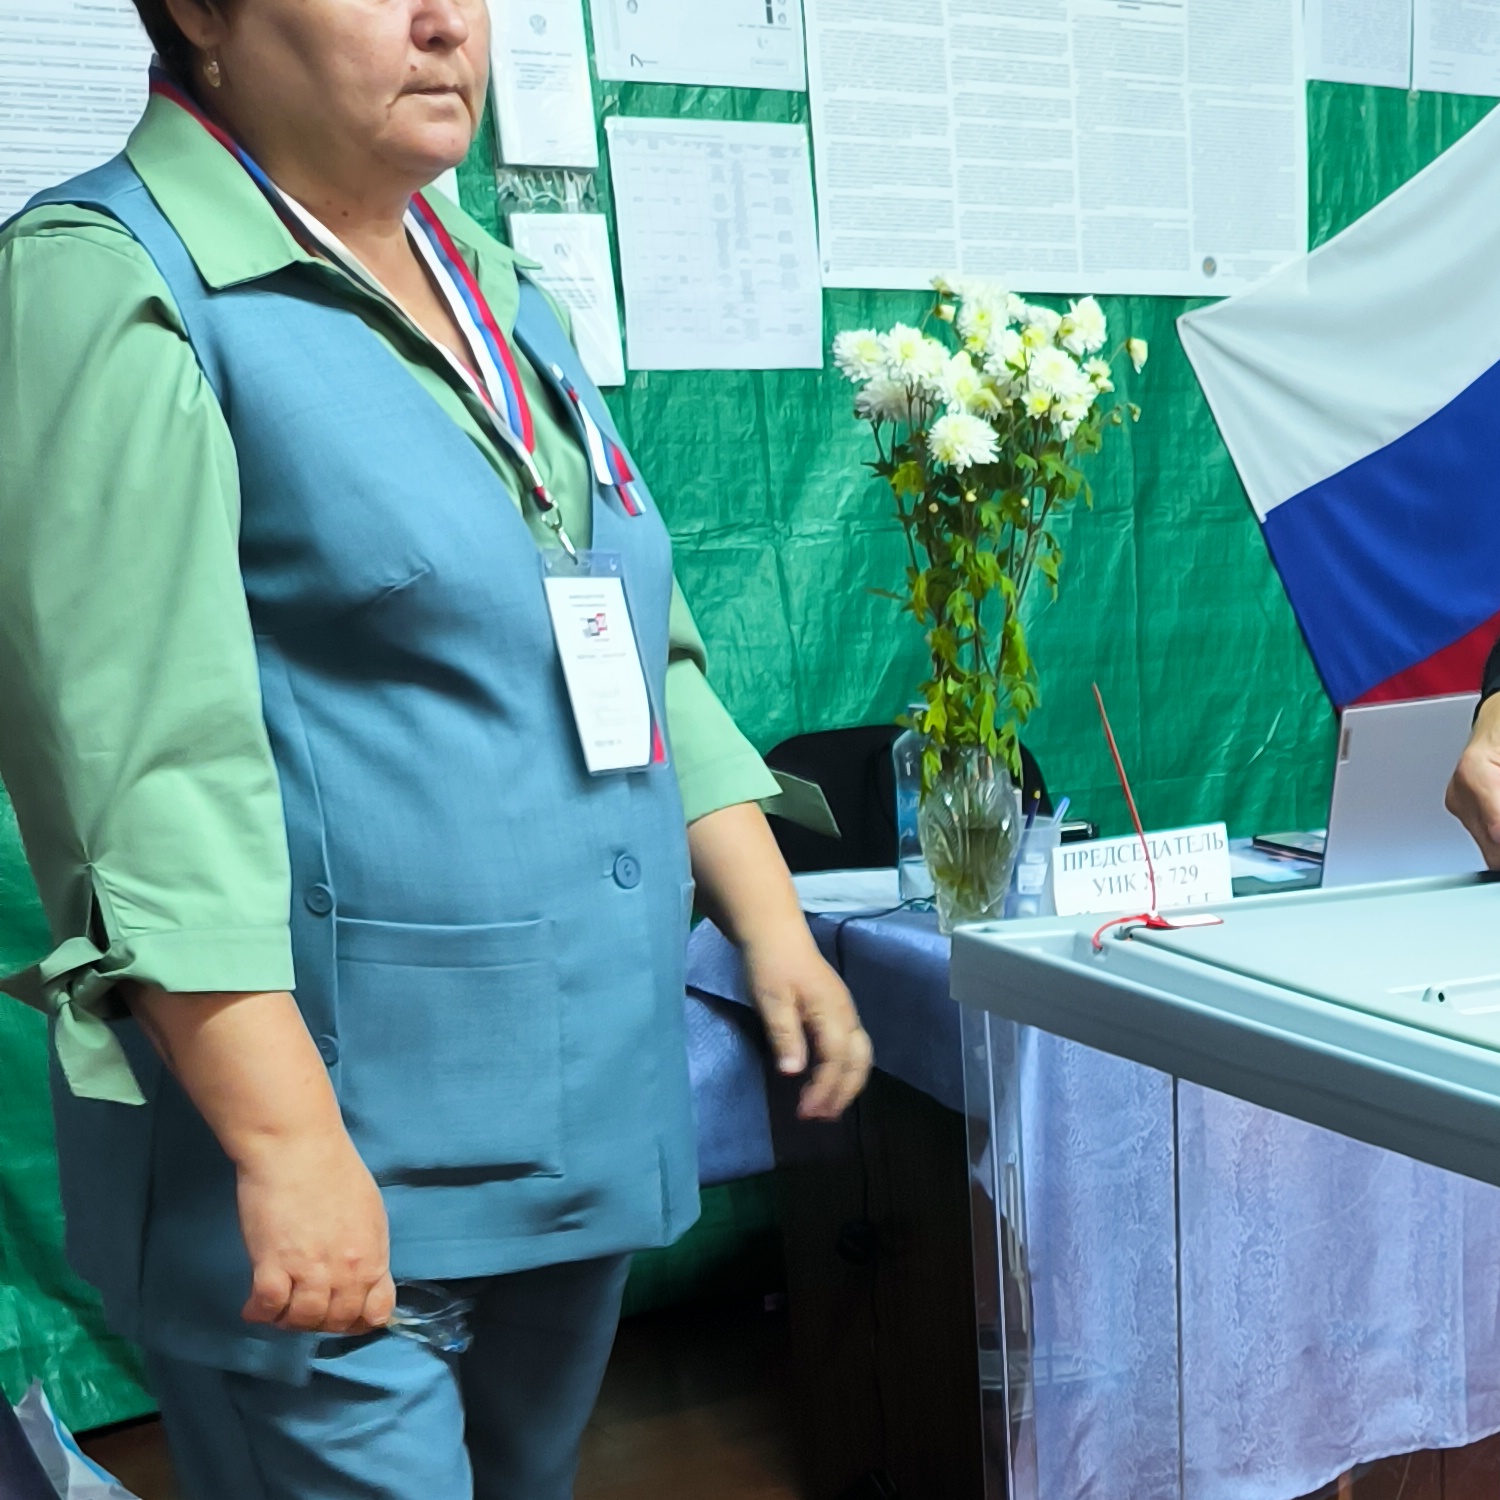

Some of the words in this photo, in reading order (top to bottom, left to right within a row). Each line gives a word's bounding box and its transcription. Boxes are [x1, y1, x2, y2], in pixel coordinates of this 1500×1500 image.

[1063, 832, 1224, 872] ПРЕДСЕДАТЕЛЬ
[1092, 872, 1137, 898] УИК
[1169, 864, 1199, 886] 729
